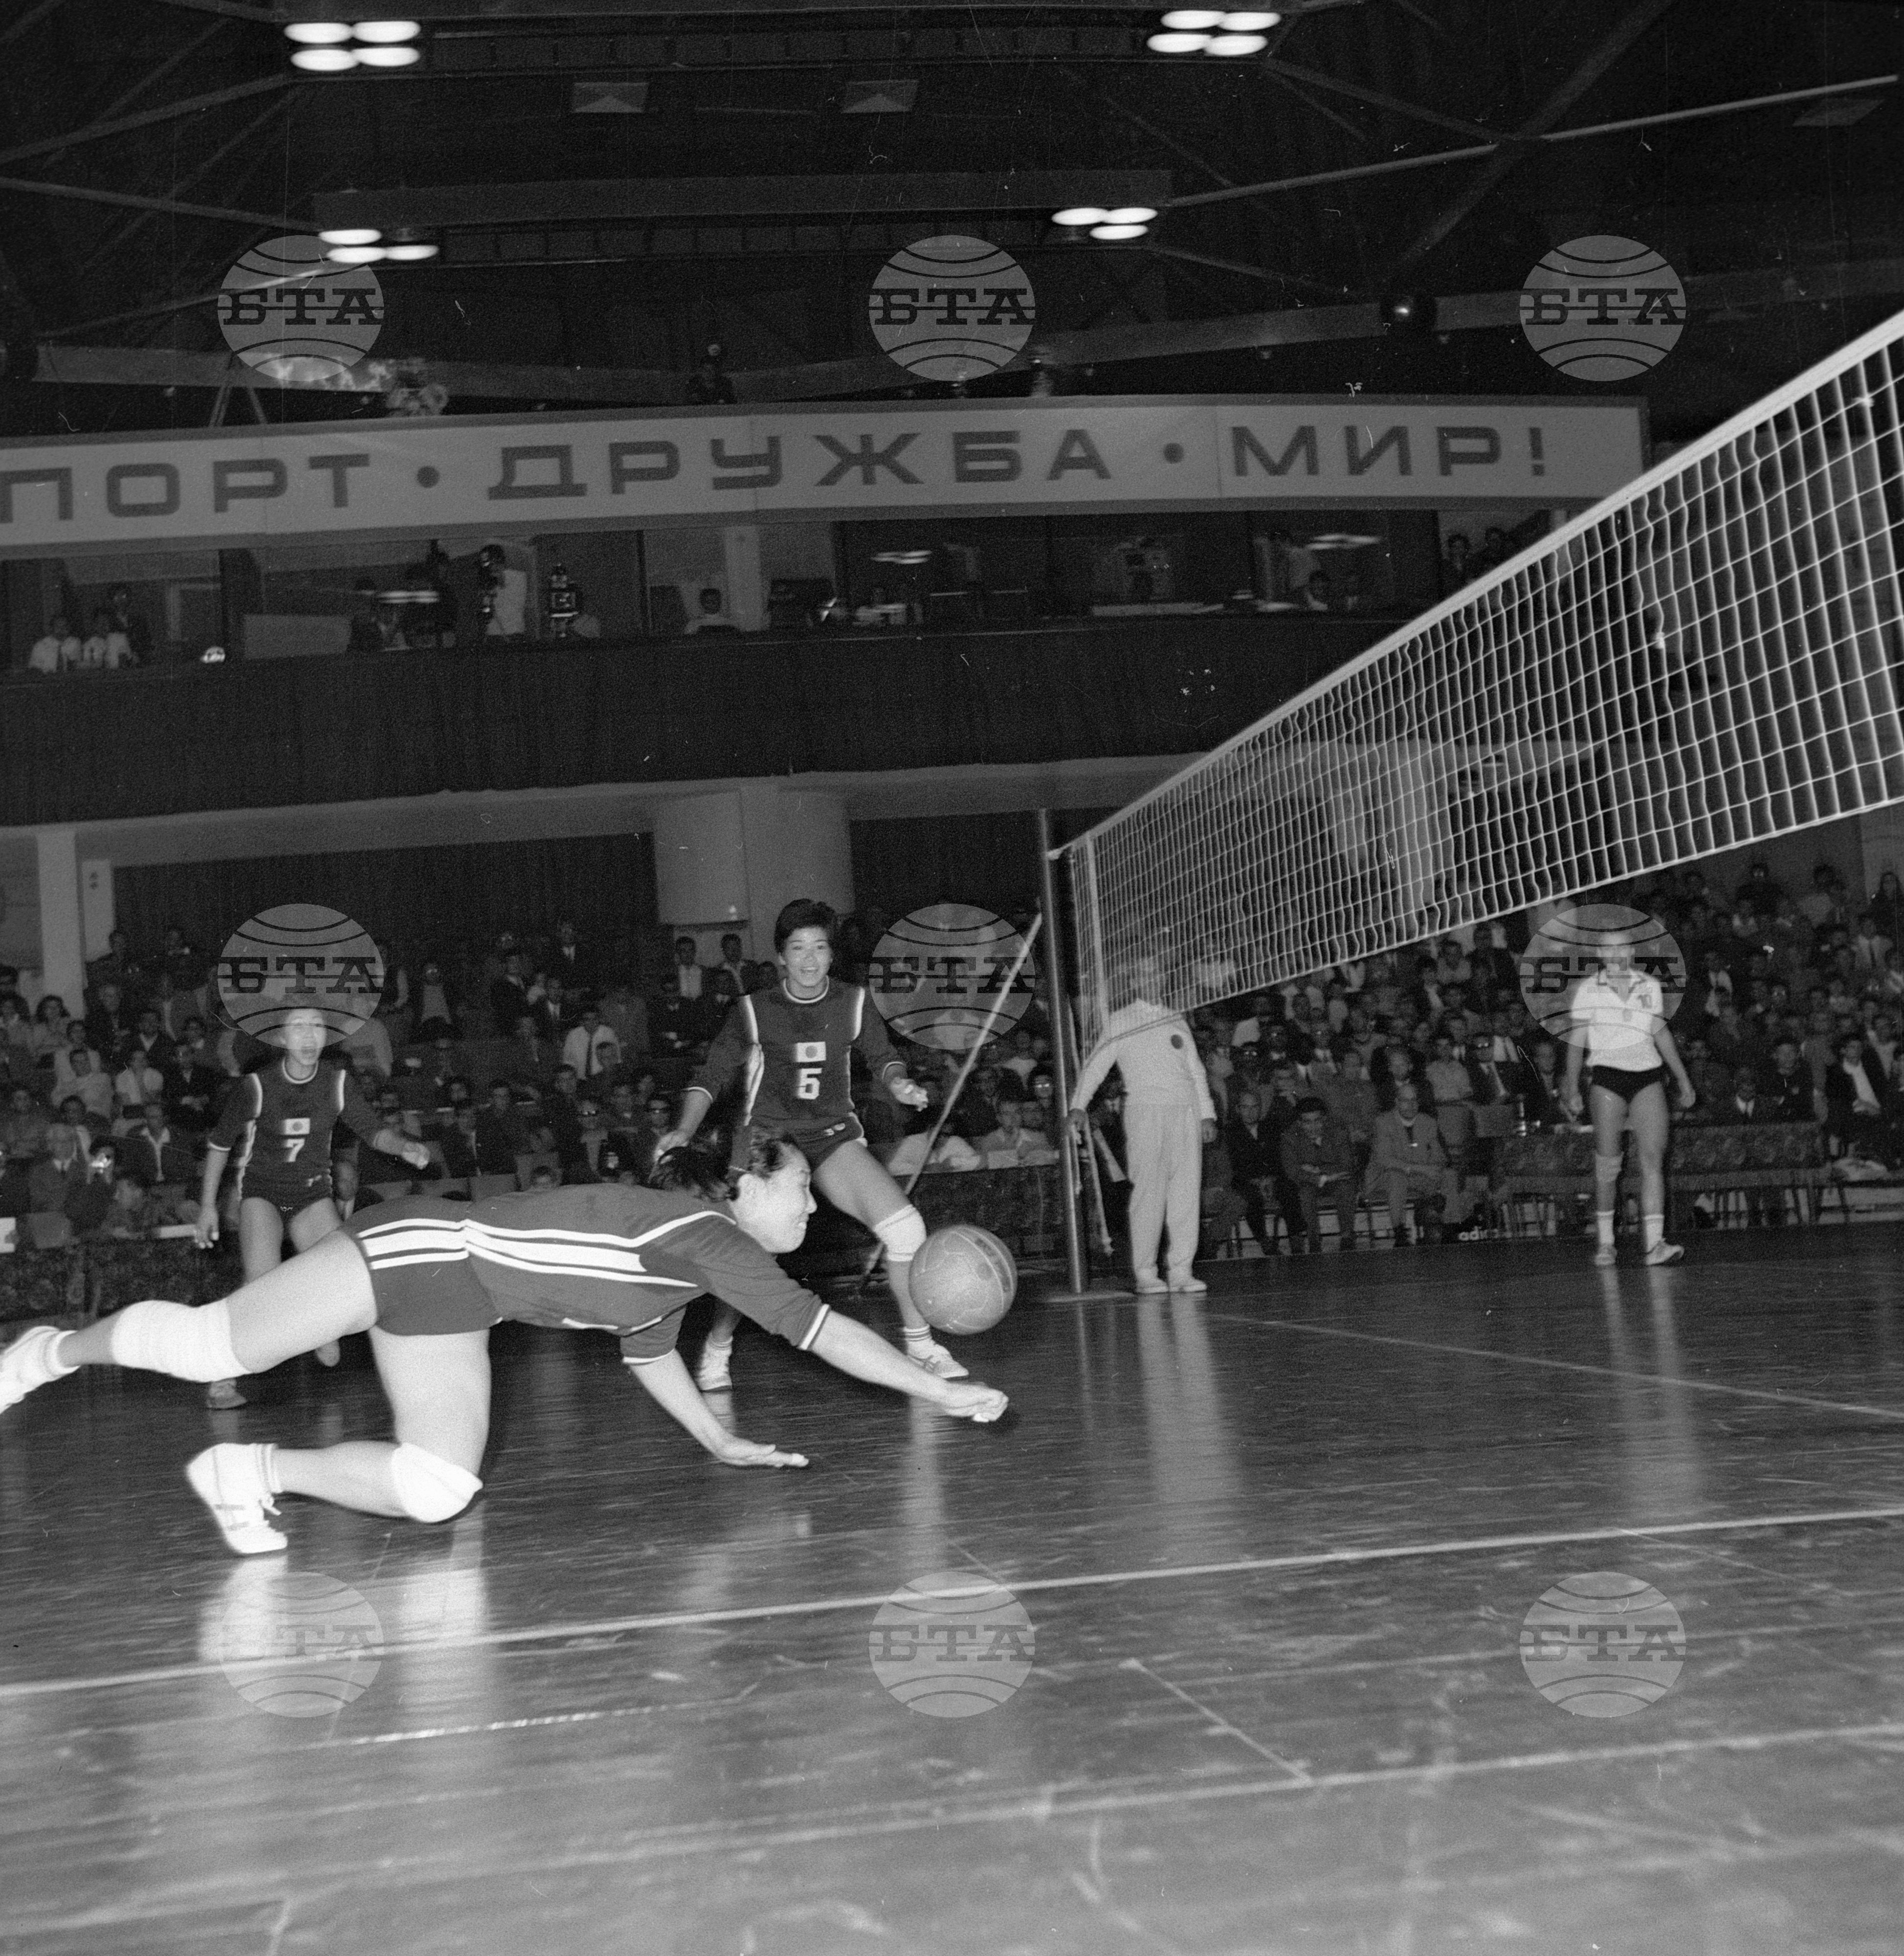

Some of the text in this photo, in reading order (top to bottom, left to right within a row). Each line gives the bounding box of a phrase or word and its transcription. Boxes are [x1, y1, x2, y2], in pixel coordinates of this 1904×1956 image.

[487, 429, 1111, 500] ДРУЖБА
[1231, 425, 1546, 477] МИР!
[285, 1138, 305, 1162] 7
